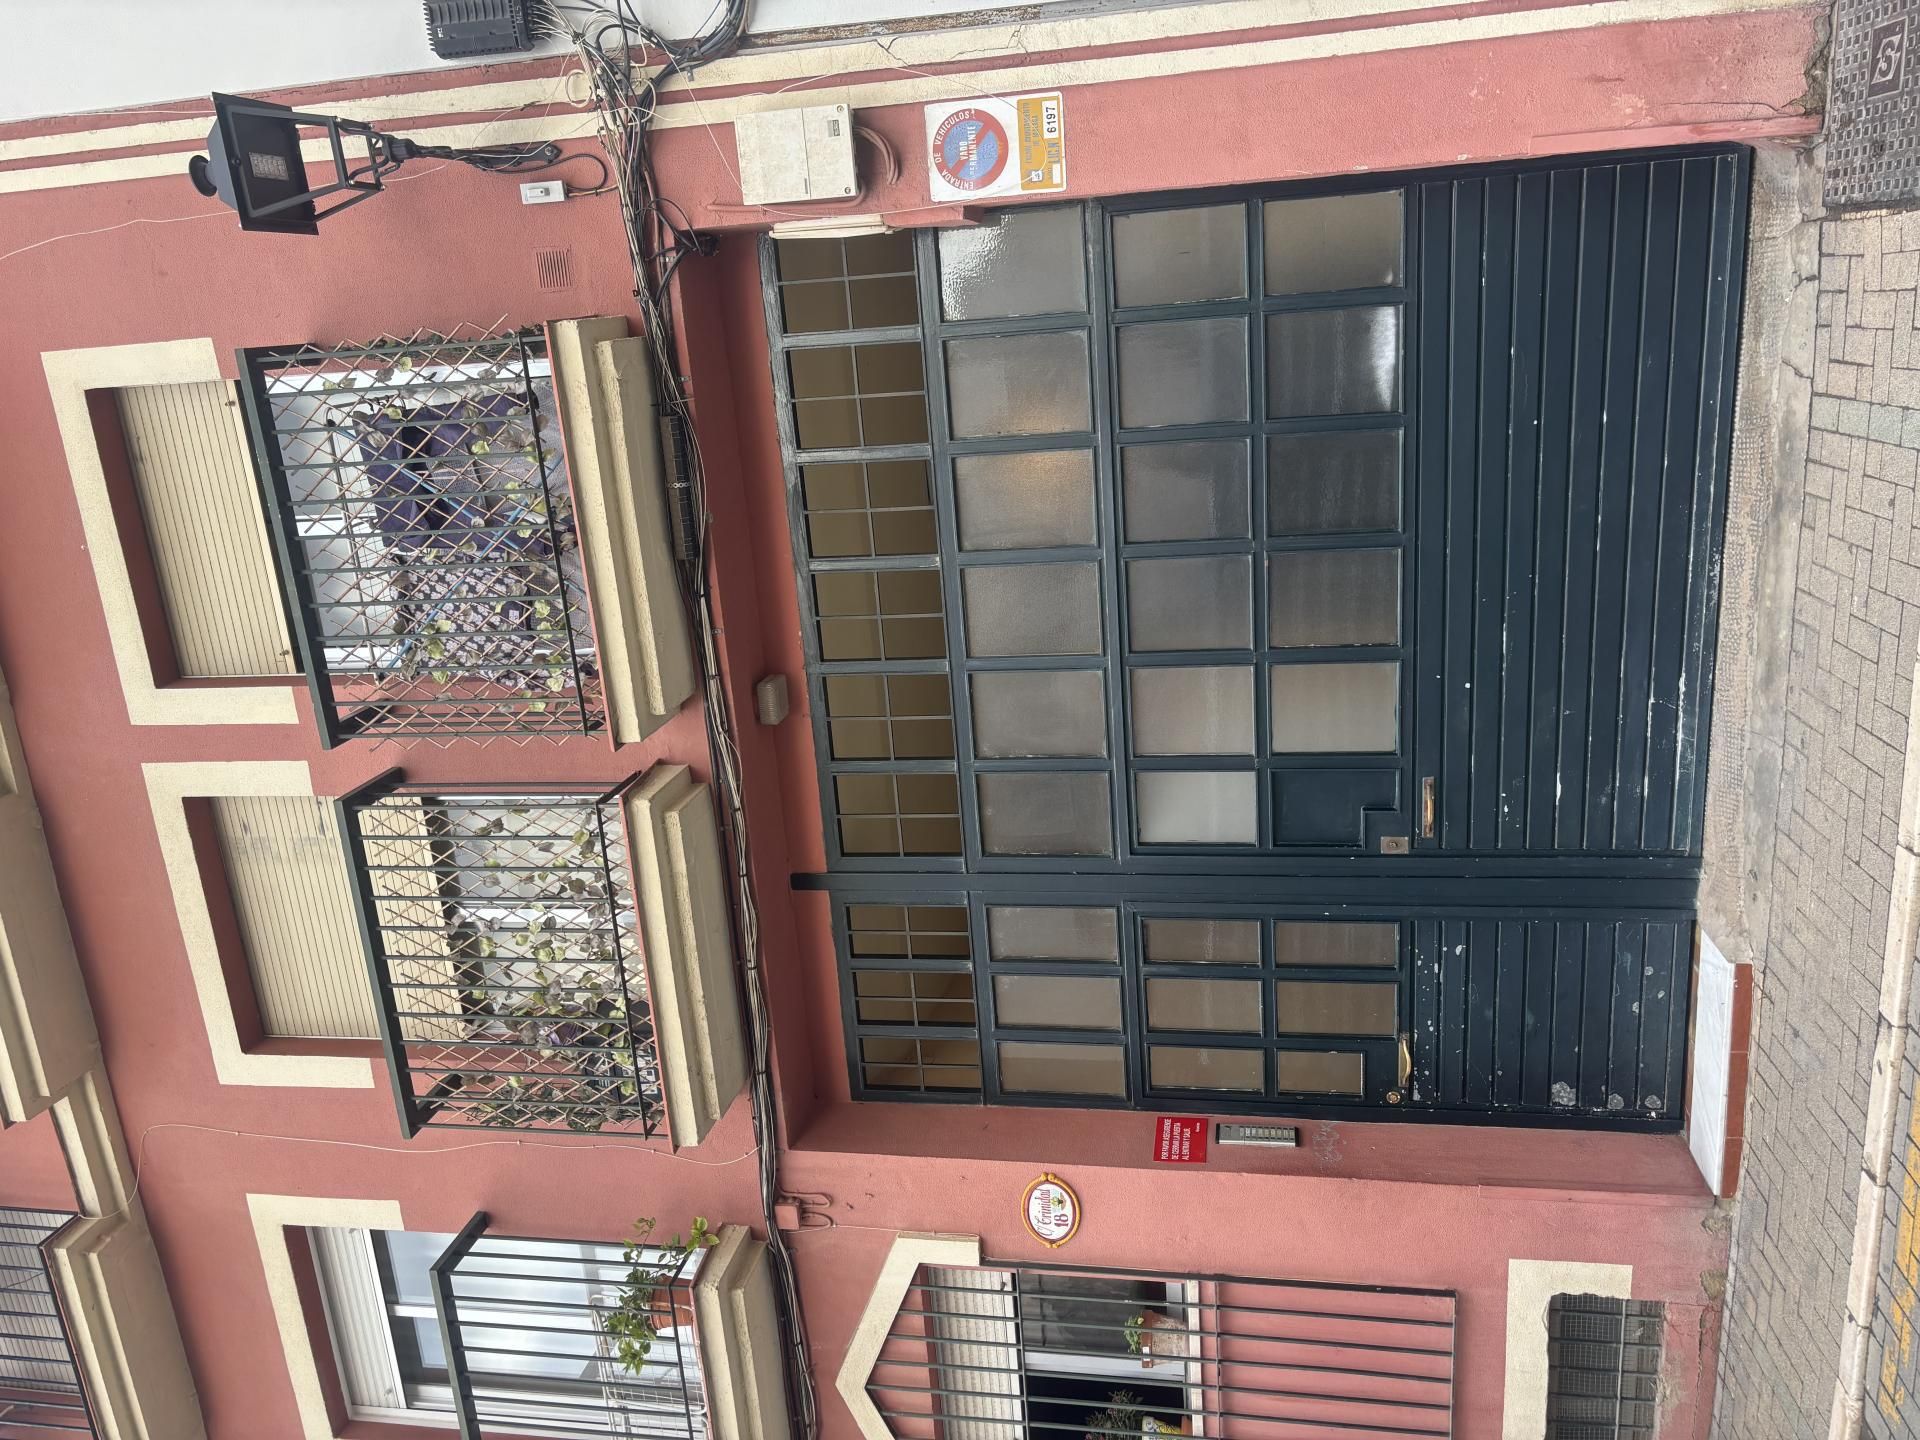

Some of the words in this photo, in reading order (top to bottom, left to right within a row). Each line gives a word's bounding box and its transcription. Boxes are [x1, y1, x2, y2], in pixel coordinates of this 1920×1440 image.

[1045, 106, 1056, 133] 6197
[934, 152, 942, 164] DE
[959, 141, 969, 161] VADO
[941, 169, 974, 190] ENTRADA
[1173, 1123, 1181, 1135] PUERTA
[1034, 1189, 1052, 1225] Trinidad
[1054, 1213, 1069, 1227] 18
